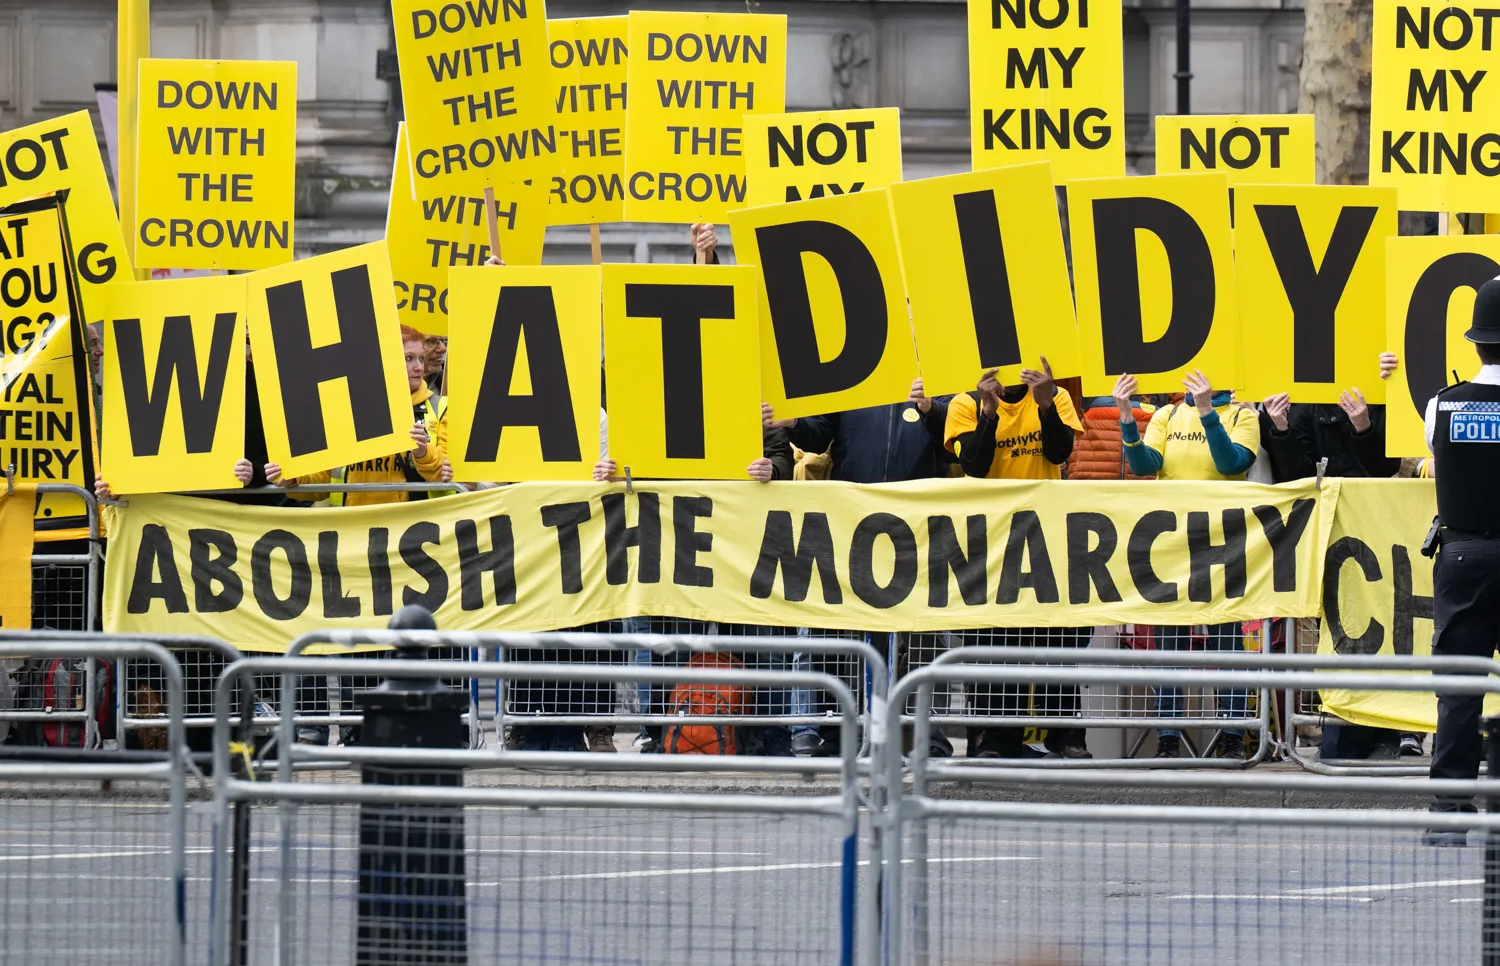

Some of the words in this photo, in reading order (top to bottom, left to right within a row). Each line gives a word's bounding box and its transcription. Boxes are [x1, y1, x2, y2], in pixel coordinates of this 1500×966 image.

[427, 39, 521, 82] WITH
[550, 38, 629, 68] OWN
[647, 32, 767, 64] DOWN
[1005, 47, 1084, 89] MY
[158, 80, 277, 110] DOWN
[443, 87, 517, 126] THE
[656, 79, 754, 110] WITH
[1406, 70, 1487, 113] MY
[167, 127, 264, 156] WITH
[560, 128, 622, 158] HE
[666, 126, 742, 156] THE
[768, 121, 874, 167] NOT
[983, 107, 1112, 151] KING
[416, 126, 556, 178] CROWN
[1180, 126, 1290, 169] NOT
[178, 173, 253, 202] THE
[549, 174, 625, 204] ROW
[628, 171, 747, 202] CROW
[423, 195, 517, 230] WITH
[140, 218, 288, 249] CROWN
[1166, 431, 1206, 444] #NotMy
[127, 514, 516, 621] ABOLISH
[541, 492, 713, 594] THE
[749, 498, 1315, 608] MONARCHY
